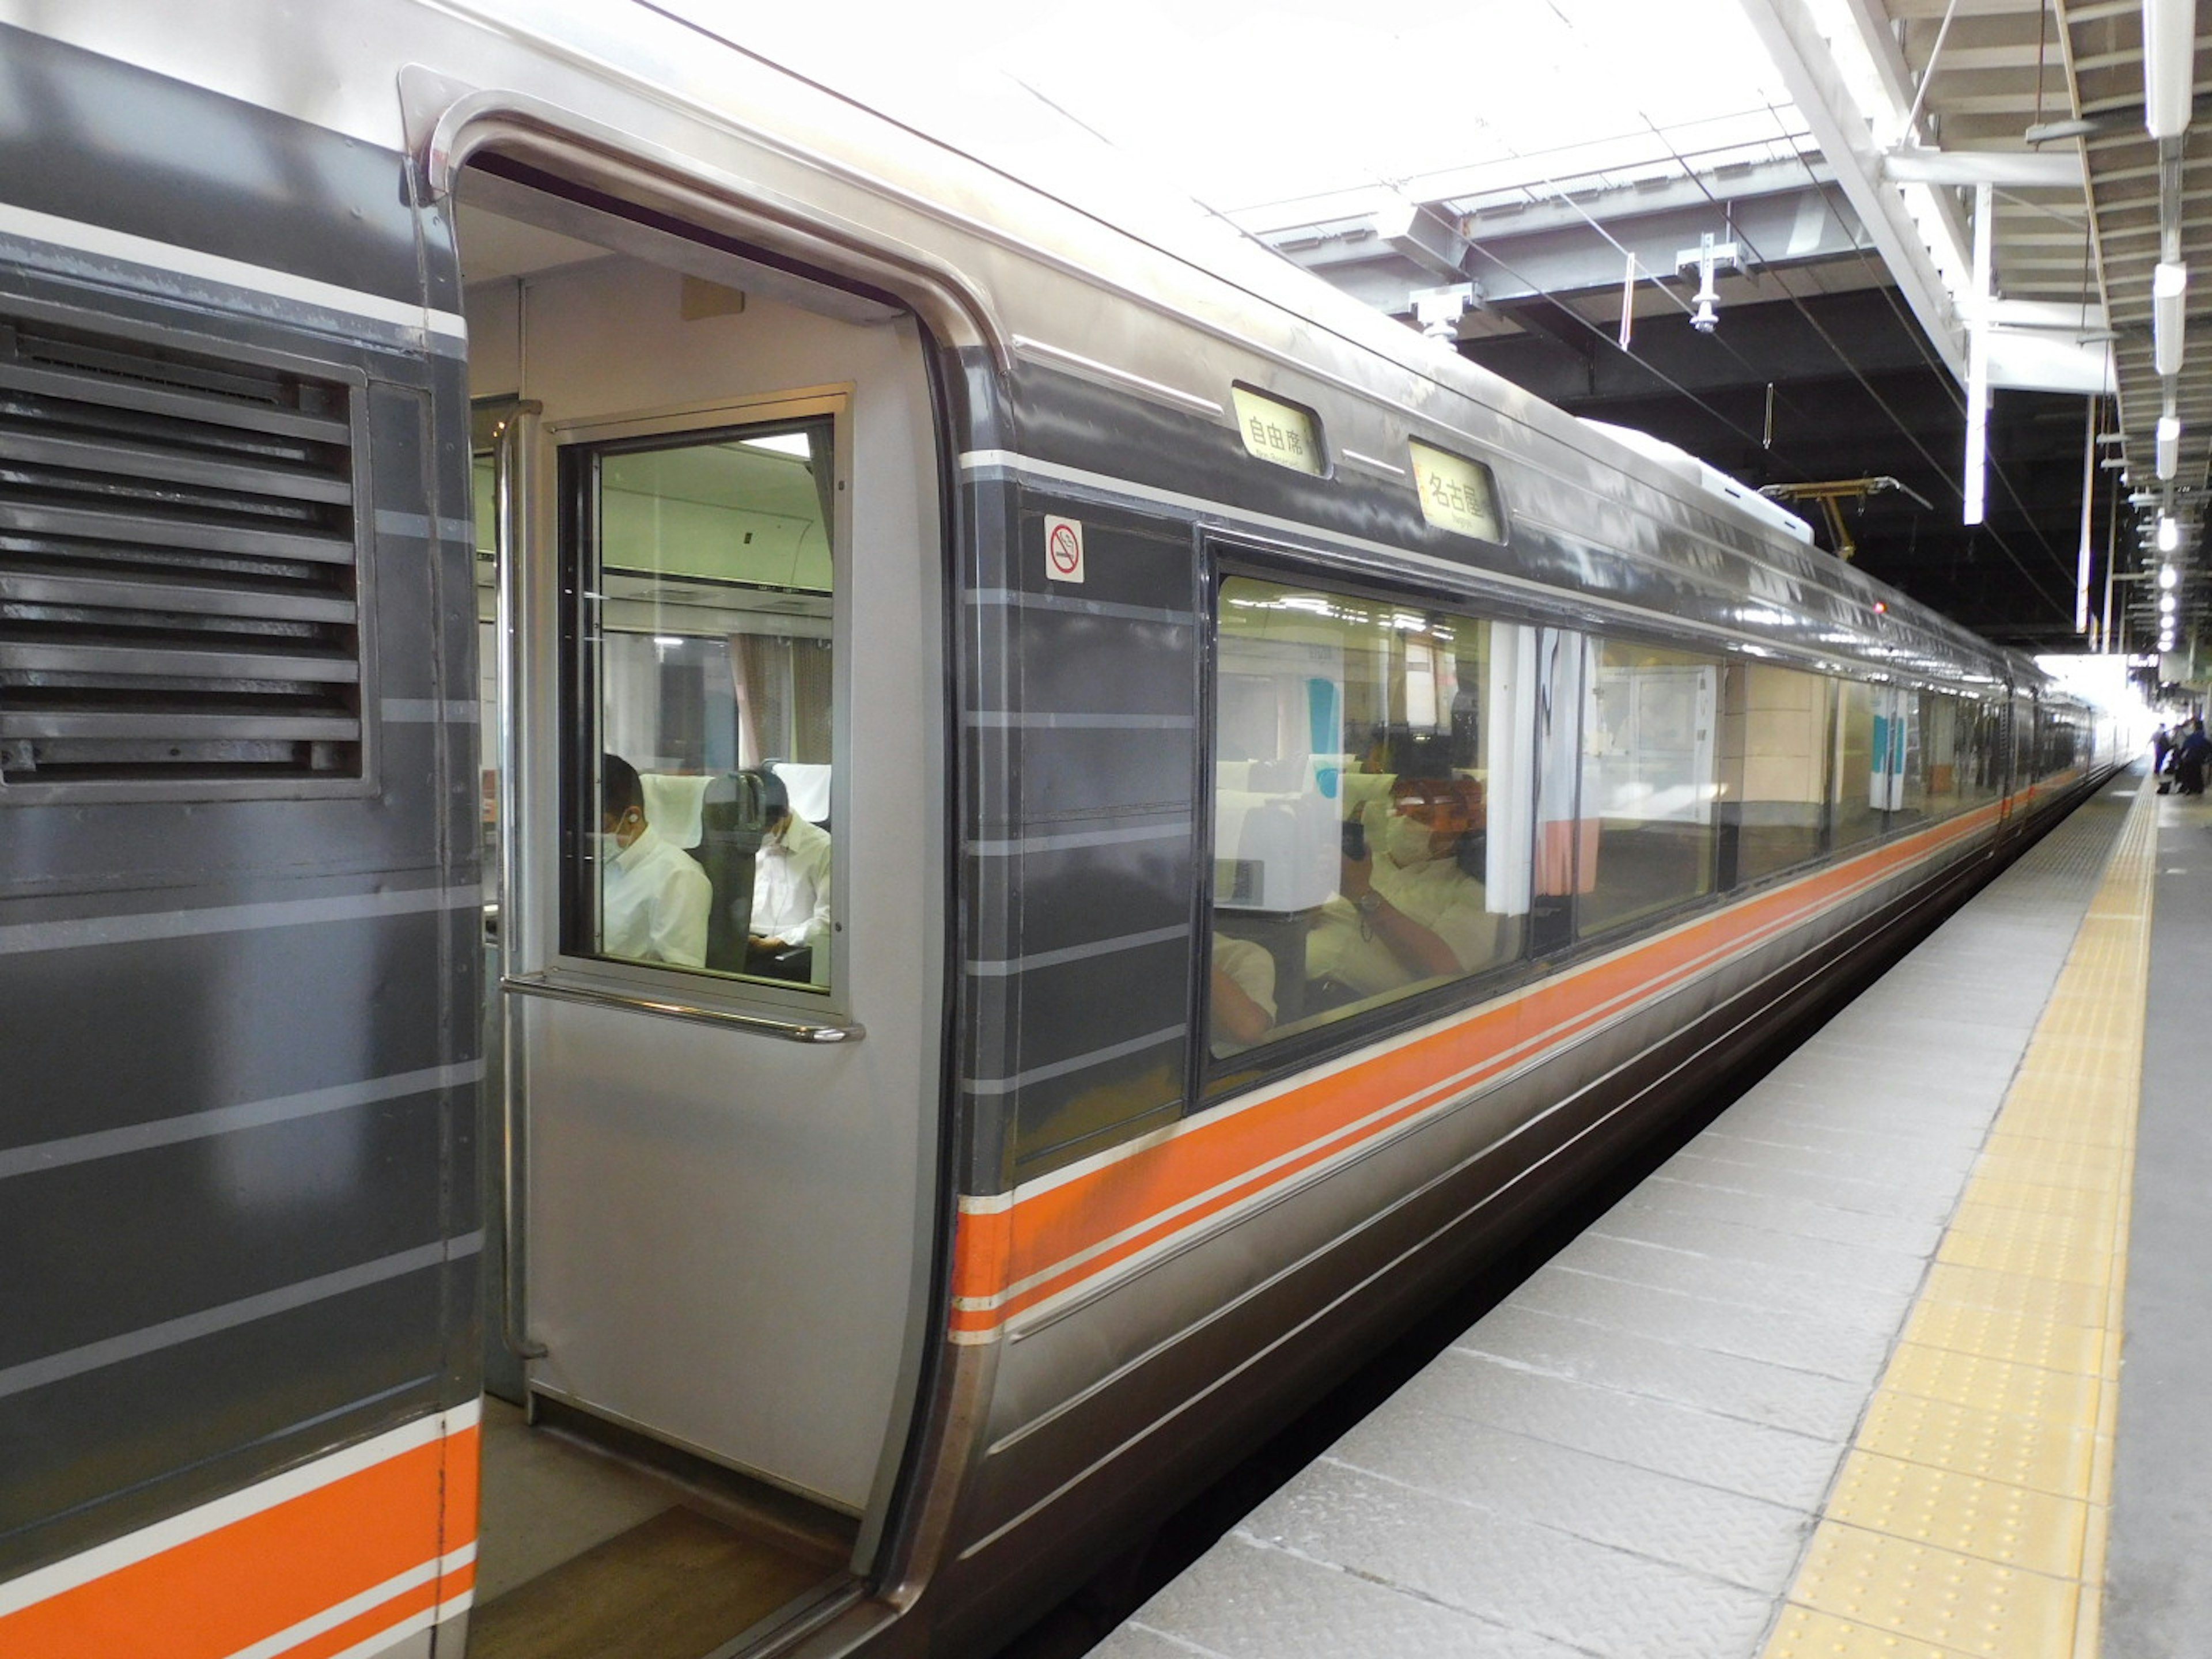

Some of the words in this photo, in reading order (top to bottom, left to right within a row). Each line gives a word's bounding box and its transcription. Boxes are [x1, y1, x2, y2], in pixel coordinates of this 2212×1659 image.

[1249, 415, 1303, 455] 自由席
[1429, 471, 1484, 518] 名古屋
